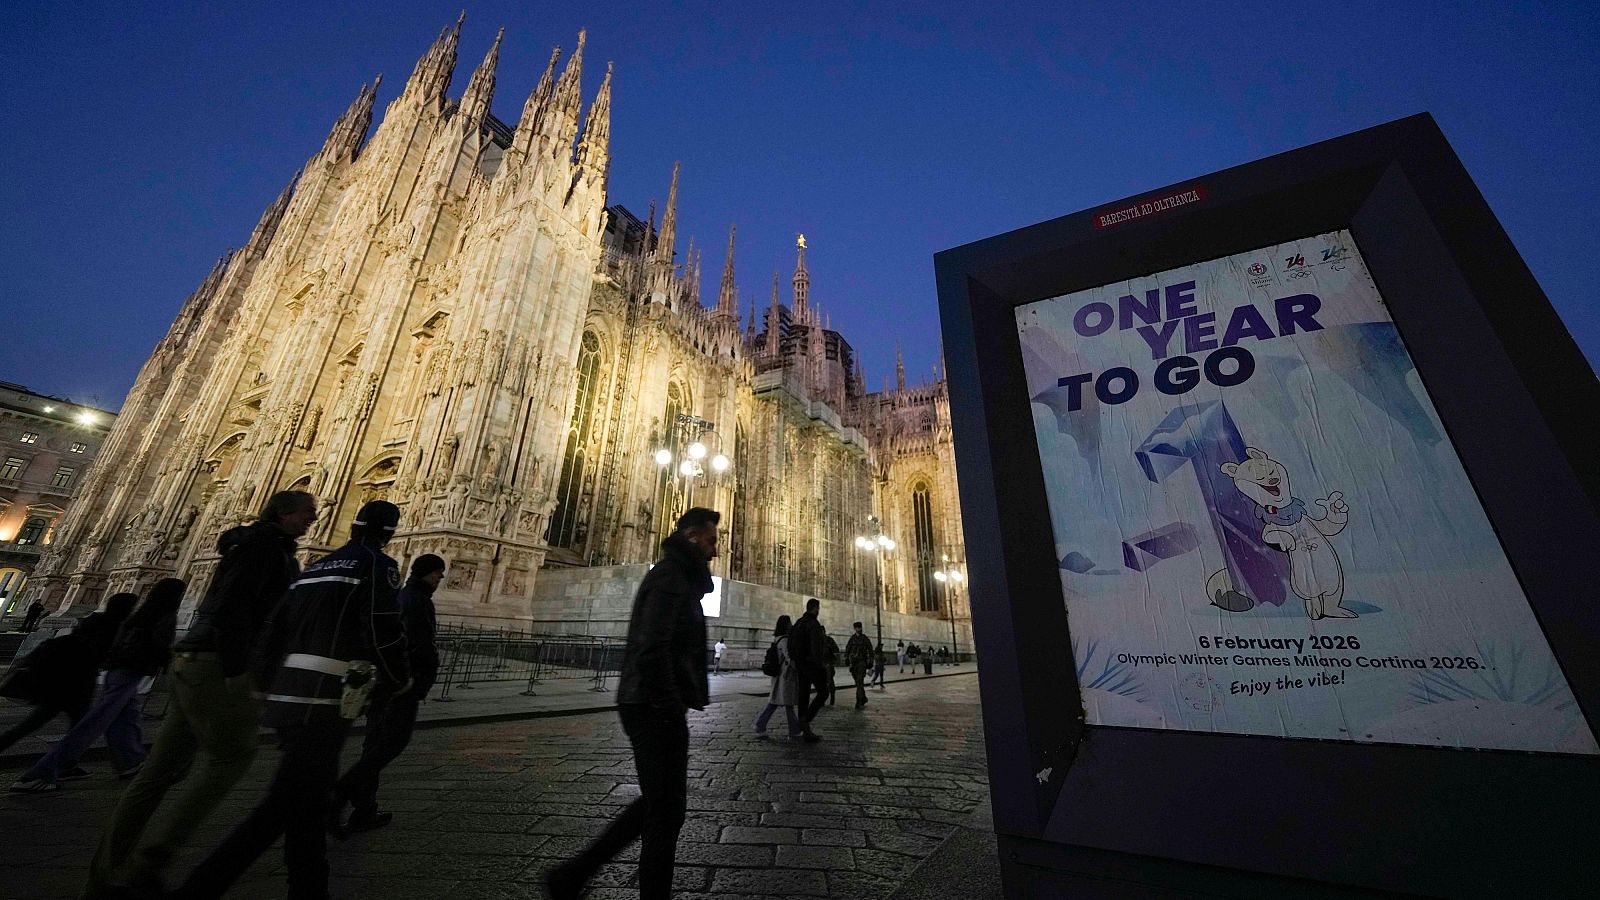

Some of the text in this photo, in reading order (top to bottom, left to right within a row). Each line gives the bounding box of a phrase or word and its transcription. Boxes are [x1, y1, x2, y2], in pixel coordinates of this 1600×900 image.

[1100, 190, 1201, 227] BARESITÀ AD OLTRANZA
[1073, 280, 1198, 337] ONE
[1136, 293, 1325, 360] YEAR
[1057, 346, 1256, 412] TO GO
[1117, 652, 1177, 668] Olympic
[1178, 653, 1229, 666] Winter
[1232, 654, 1290, 667] Games
[1293, 654, 1352, 668] Milano
[1356, 655, 1427, 669] Cortina
[1198, 635, 1361, 654] 6 February 2026
[1229, 679, 1272, 697] Enjoy
[1275, 675, 1304, 690] the
[1307, 670, 1346, 687] vibe!
